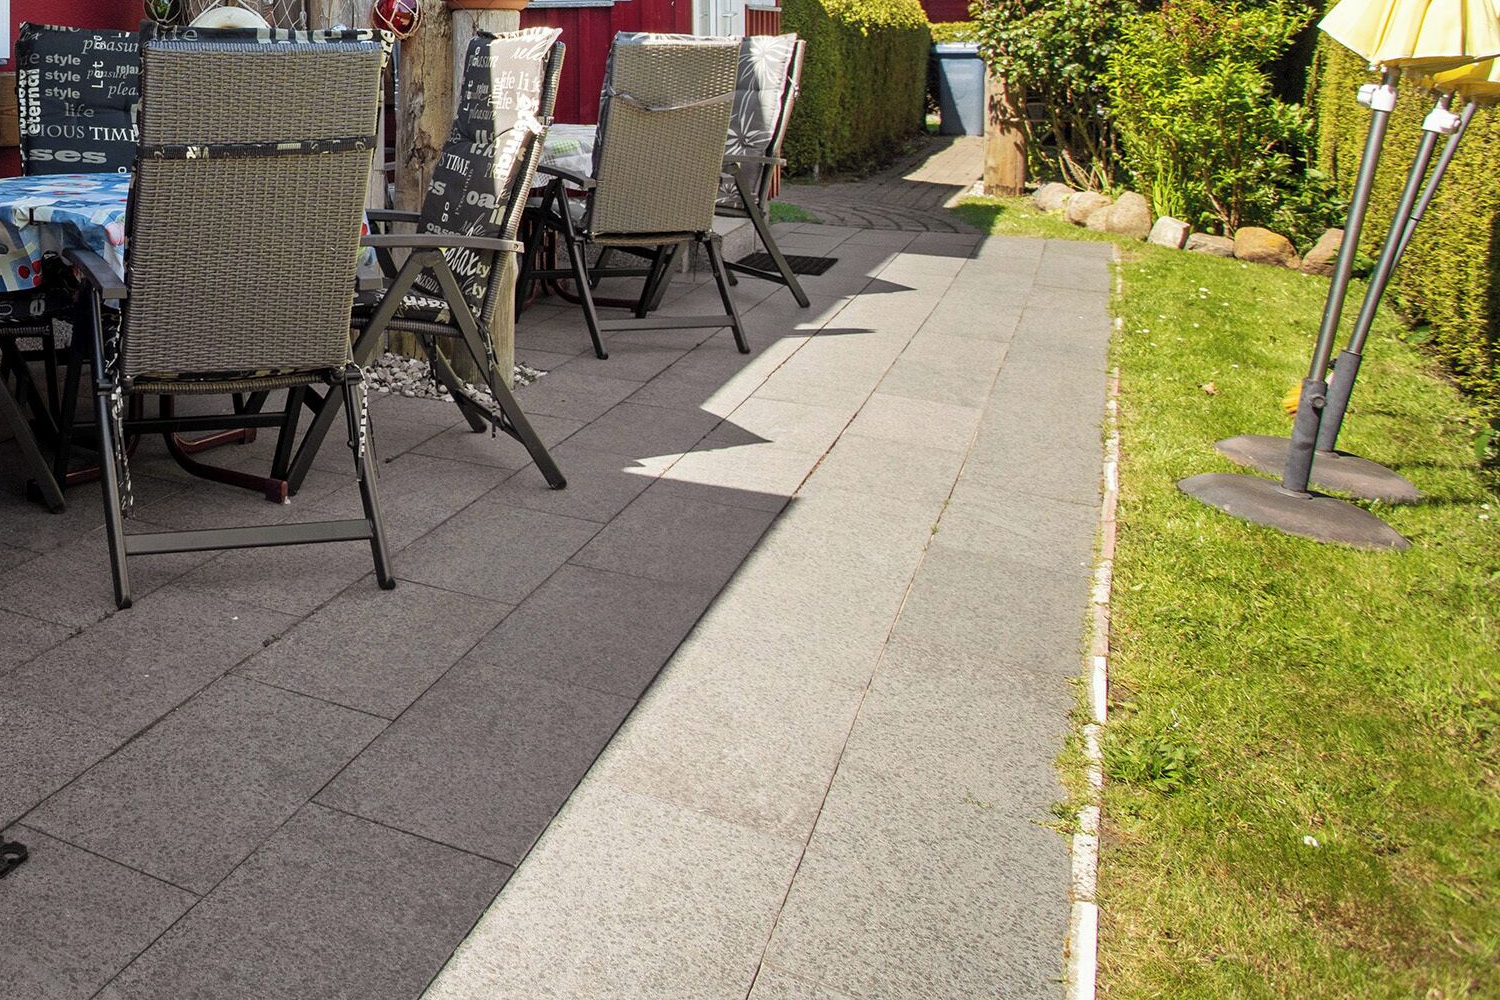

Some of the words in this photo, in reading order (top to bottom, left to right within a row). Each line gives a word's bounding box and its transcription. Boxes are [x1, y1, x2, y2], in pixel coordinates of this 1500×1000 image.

[45, 54, 81, 67] style
[45, 70, 81, 83] style
[45, 87, 81, 100] style
[27, 68, 41, 135] eternal
[64, 102, 95, 118] life
[445, 153, 470, 176] TIME
